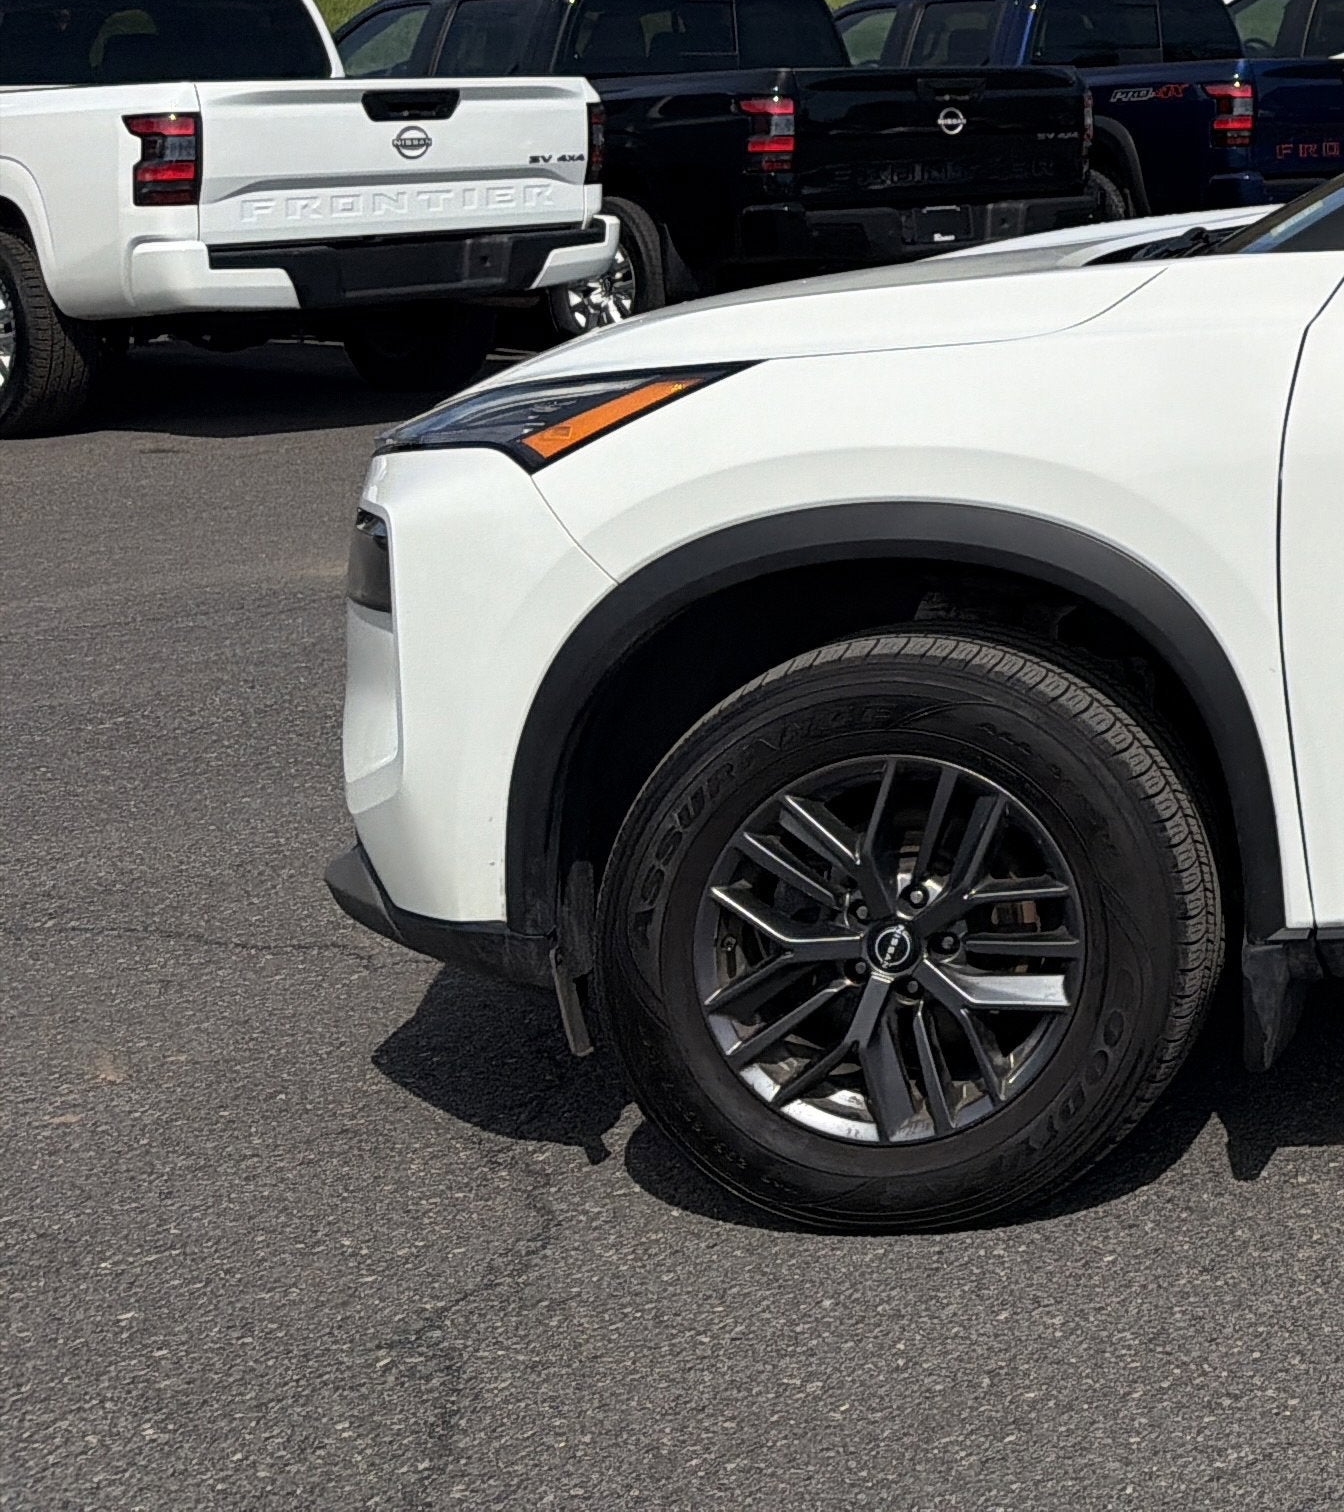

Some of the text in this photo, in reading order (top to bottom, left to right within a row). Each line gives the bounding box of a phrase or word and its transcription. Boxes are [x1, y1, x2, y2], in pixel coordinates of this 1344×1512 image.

[392, 136, 433, 147] NISSAN
[529, 154, 553, 164] SV
[239, 183, 557, 224] FRONTIER
[881, 924, 905, 969] NISSAN
